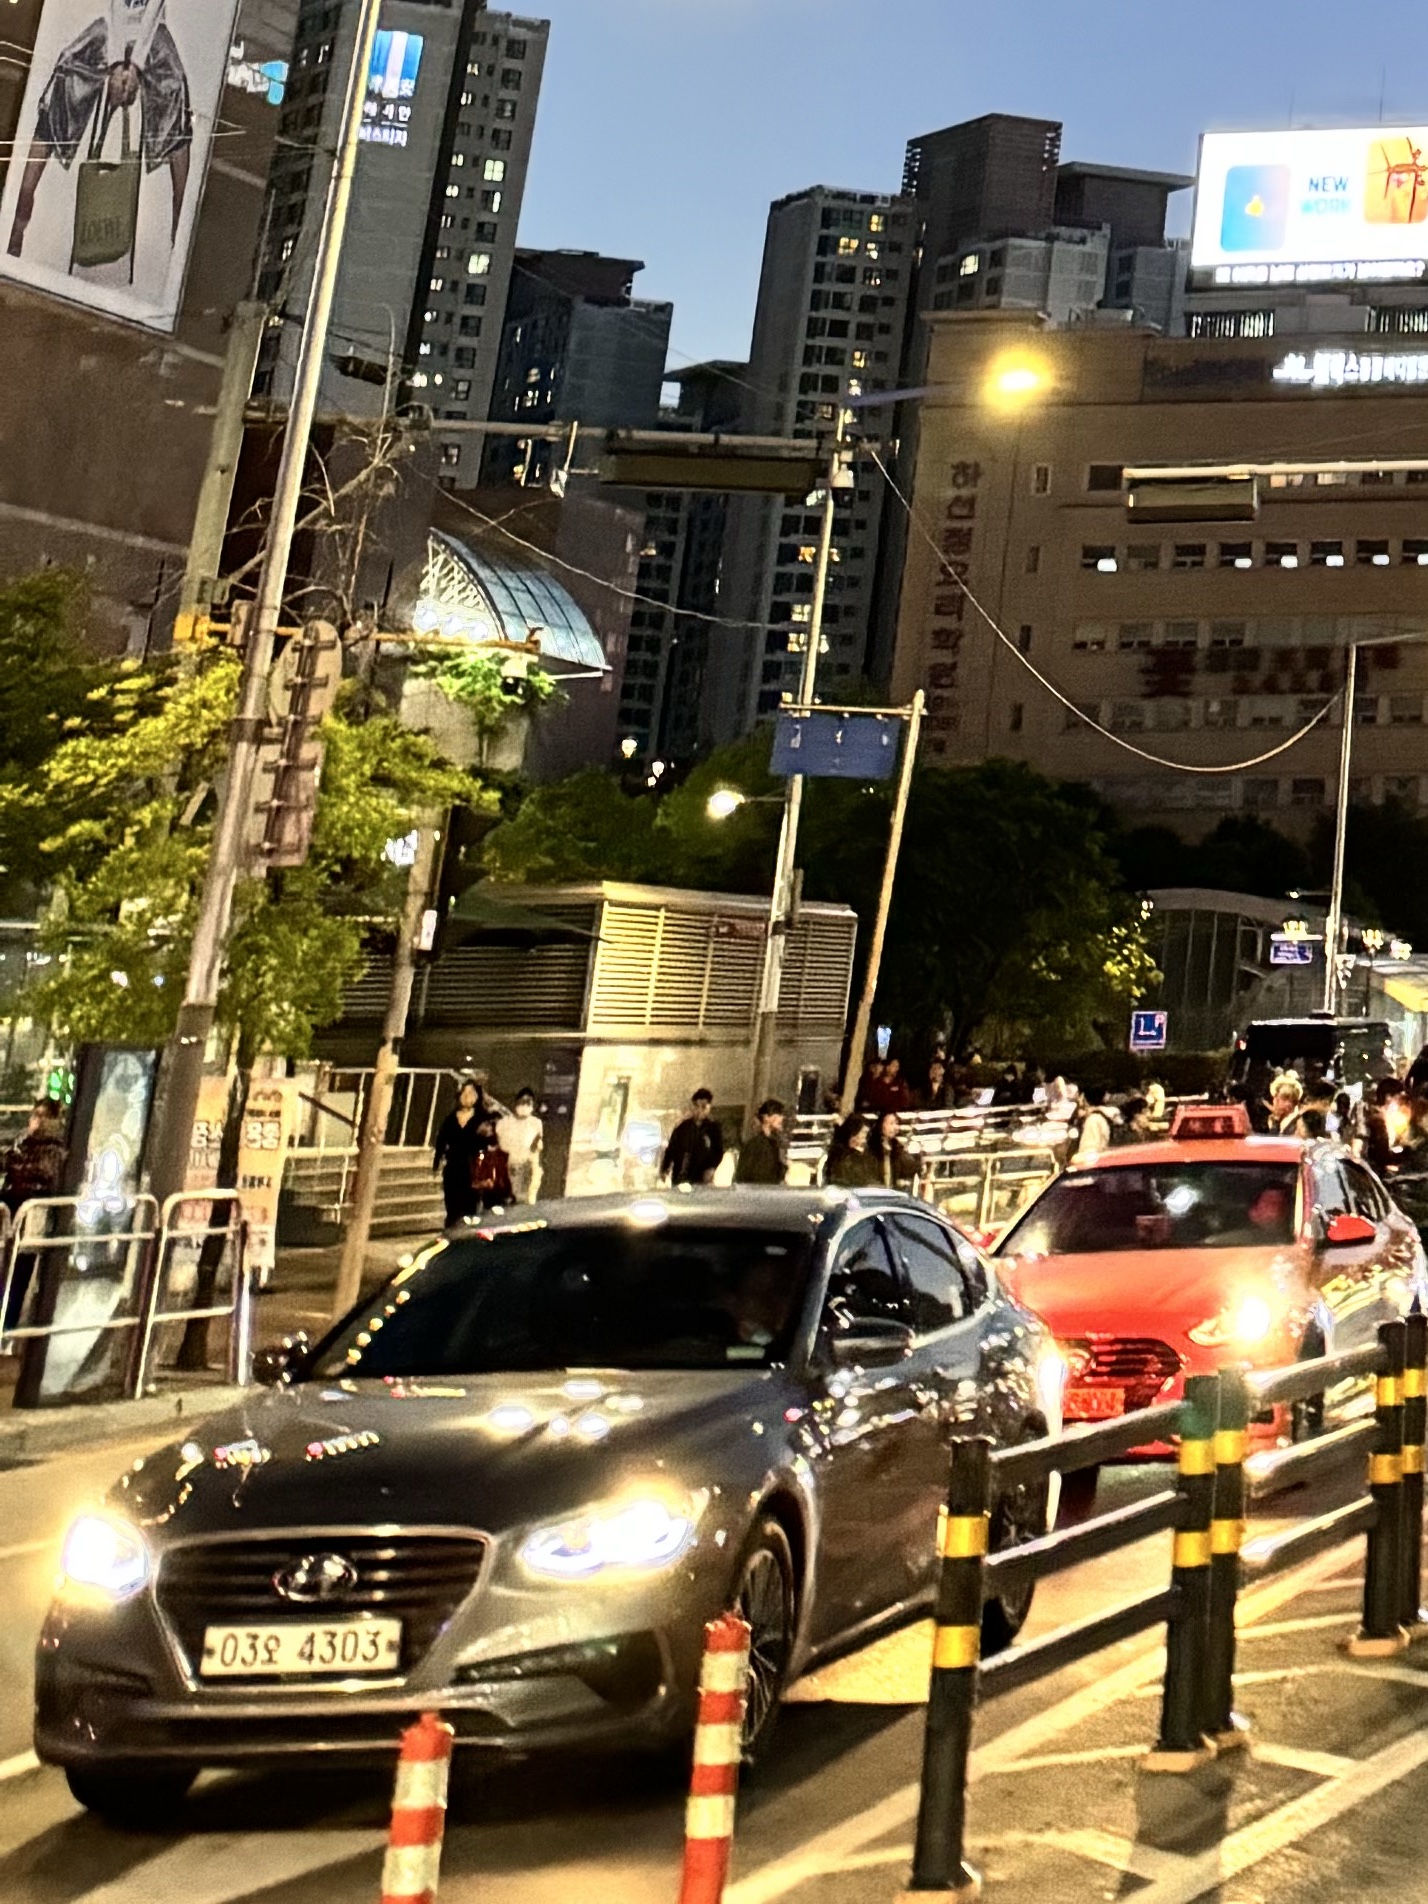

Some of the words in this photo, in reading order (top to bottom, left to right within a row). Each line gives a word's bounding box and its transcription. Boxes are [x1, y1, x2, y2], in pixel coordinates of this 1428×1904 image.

[1308, 176, 1350, 192] NEW
[220, 1632, 281, 1667] 03오
[298, 1630, 381, 1665] 4303
